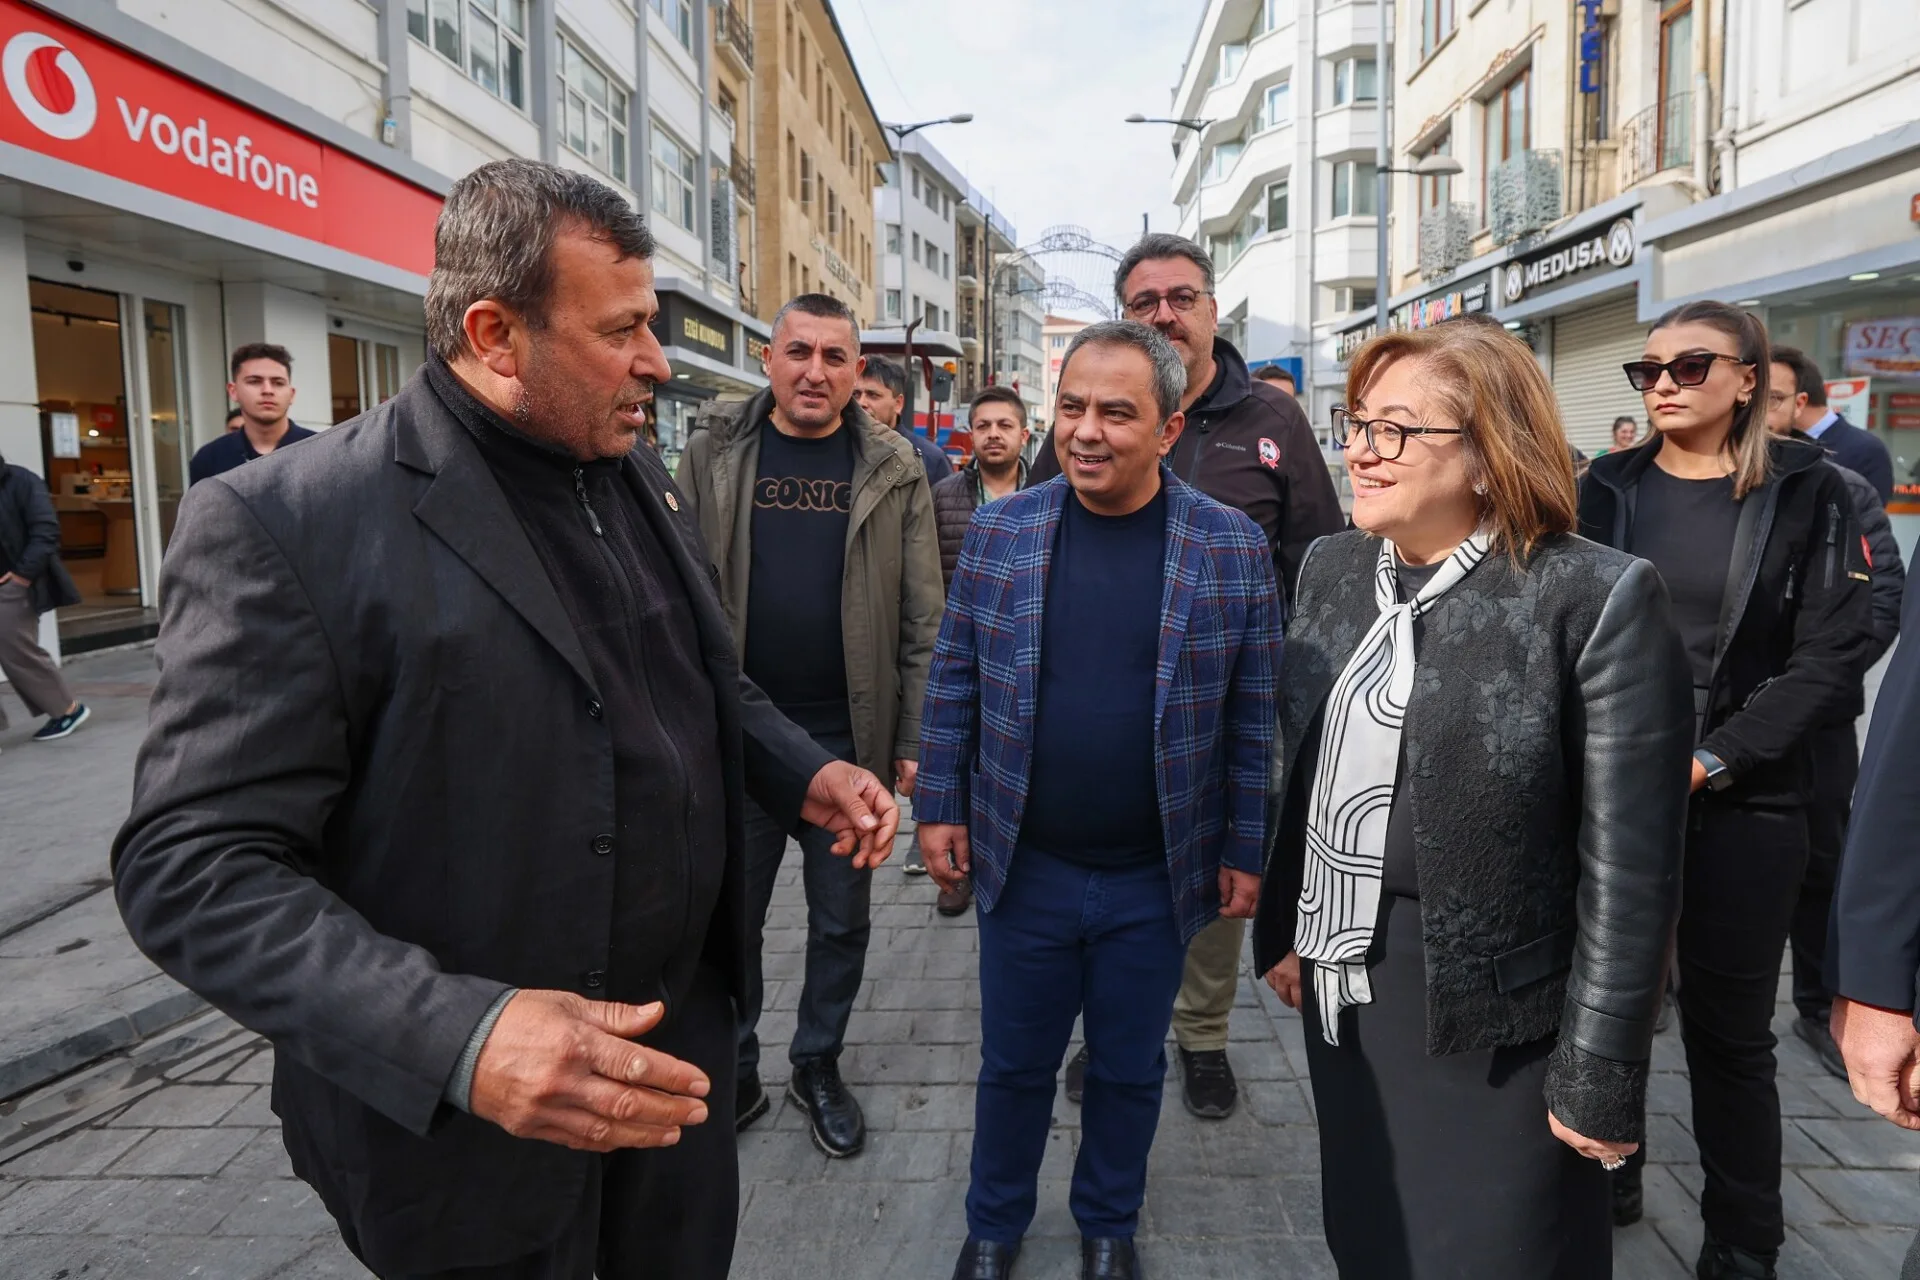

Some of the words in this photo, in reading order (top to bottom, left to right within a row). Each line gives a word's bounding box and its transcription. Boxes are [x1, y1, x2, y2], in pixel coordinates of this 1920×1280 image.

[116, 96, 320, 208] vodafone
[1523, 236, 1606, 288] MEDUSA
[1221, 441, 1247, 452] Columbia
